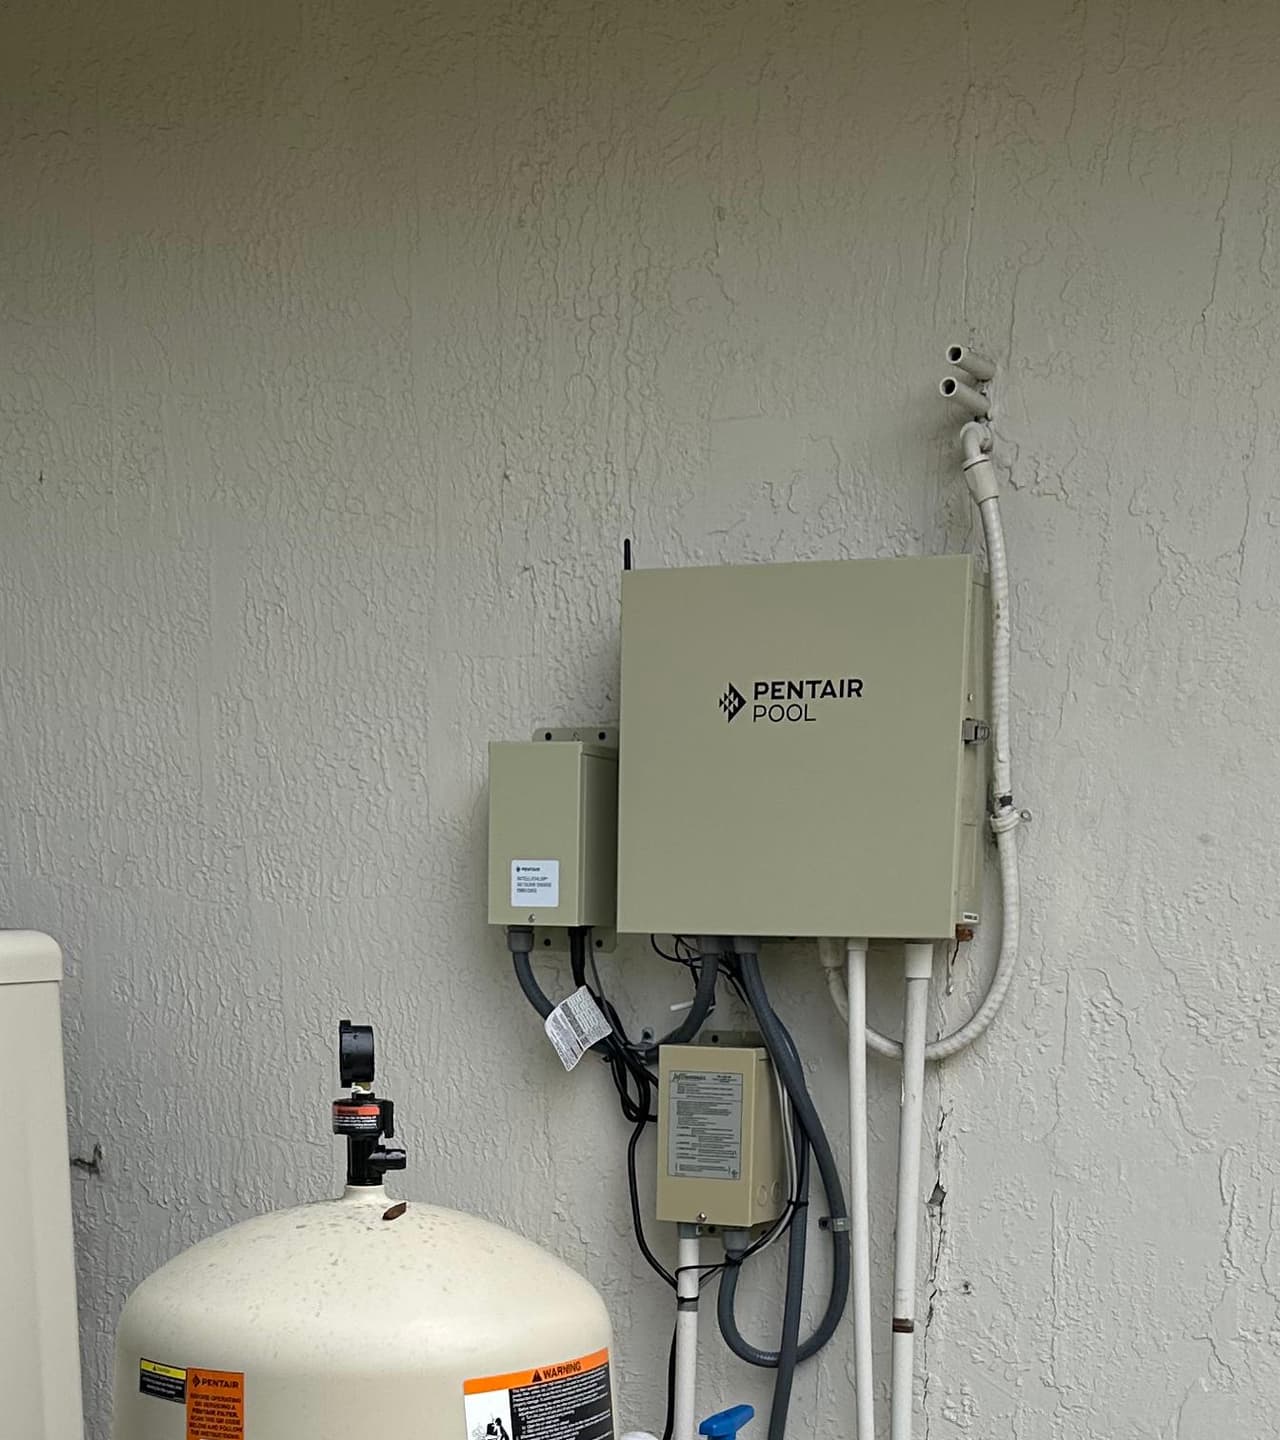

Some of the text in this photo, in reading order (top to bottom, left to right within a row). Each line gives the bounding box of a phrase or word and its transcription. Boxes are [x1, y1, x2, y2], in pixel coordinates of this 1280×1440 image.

[753, 678, 864, 701] PENTAIR
[752, 704, 817, 723] POOL
[542, 1361, 582, 1380] WARNING
[201, 1377, 239, 1388] PENTAIR
